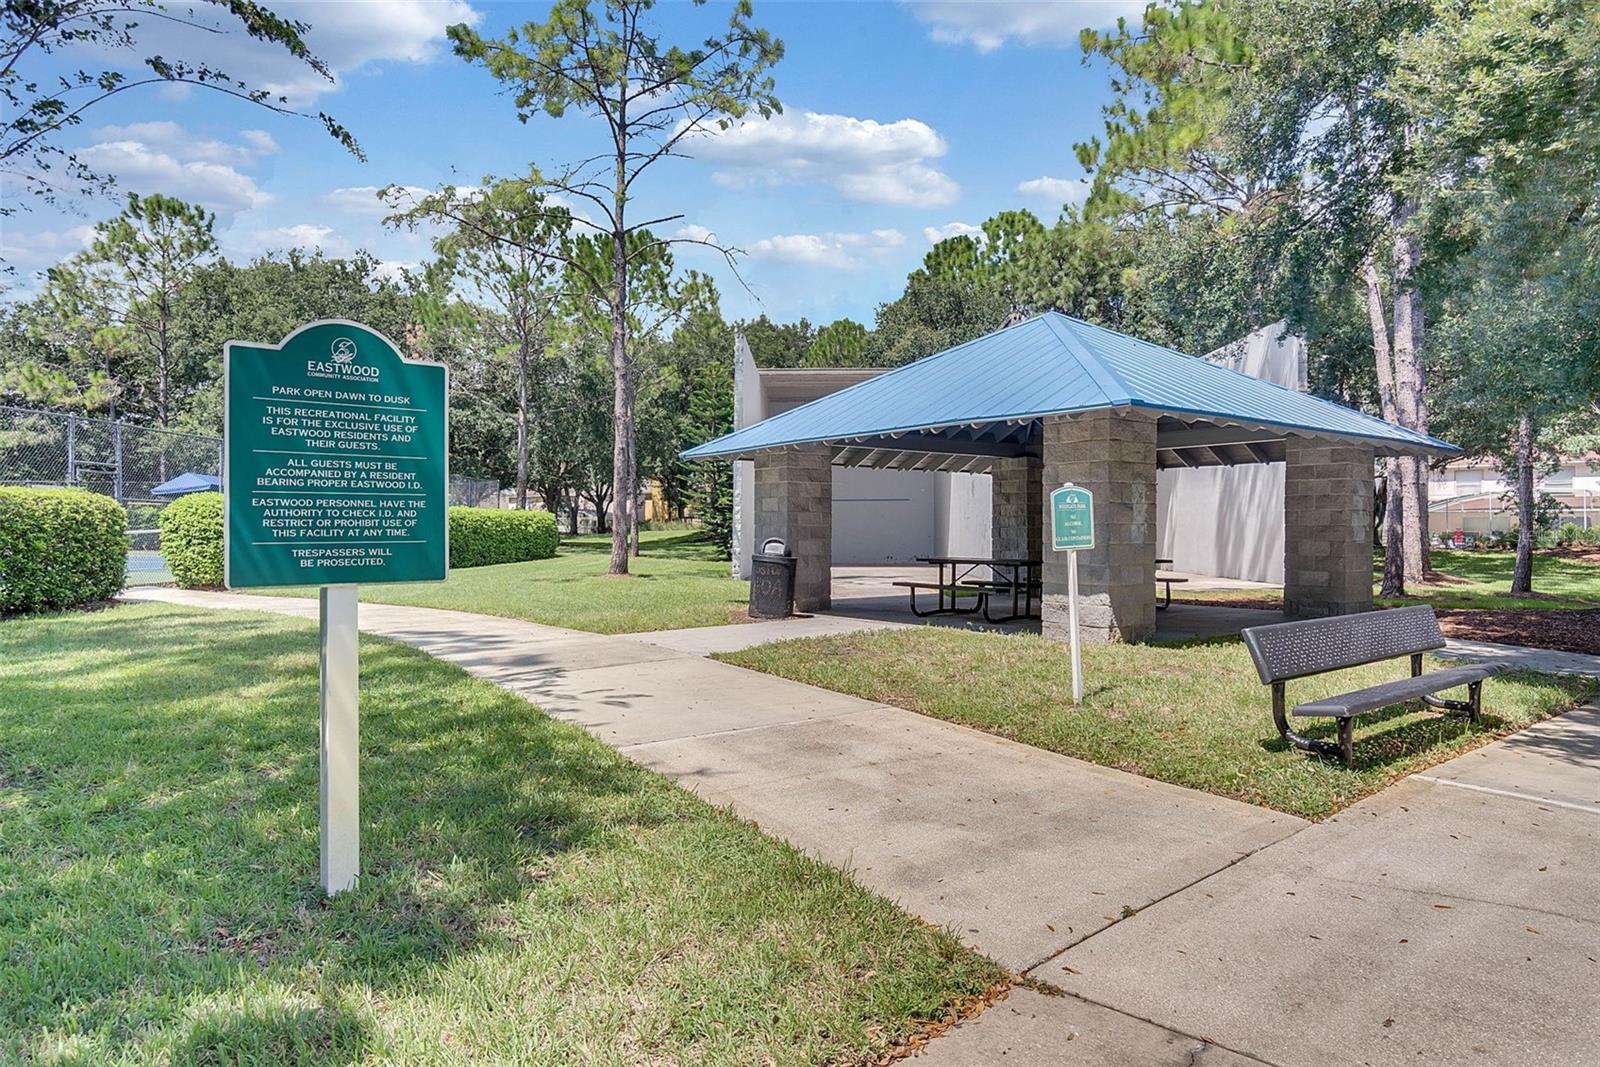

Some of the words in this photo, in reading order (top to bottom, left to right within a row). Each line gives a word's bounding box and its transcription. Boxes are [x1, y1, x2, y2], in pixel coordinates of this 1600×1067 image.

[307, 360, 379, 377] EASTWOOD
[272, 386, 300, 396] PARK
[304, 389, 332, 398] OPEN
[335, 392, 366, 401] DAWN
[369, 394, 381, 402] TO
[384, 396, 410, 404] DUSK
[266, 406, 291, 416] THIS
[294, 408, 371, 421] RECREATIONAL
[374, 414, 416, 423] FACILITY
[263, 416, 273, 424] IS
[277, 417, 298, 426] FOR
[301, 419, 321, 427] THE
[325, 420, 380, 431] EXCLUSIVE
[384, 424, 402, 432] USE
[405, 425, 418, 433] OF
[271, 427, 331, 438] EASTWOOD
[334, 432, 388, 441] RESIDENTS
[391, 434, 411, 442] AND
[305, 438, 336, 448] THEIR
[338, 441, 381, 450] GUESTS.
[287, 458, 308, 467] ALL
[311, 460, 351, 468] GUESTS
[385, 462, 397, 470] BE
[265, 468, 341, 478] ACCOMPANIED
[370, 472, 416, 480] RESIDENT
[257, 478, 304, 487] BEARING
[307, 479, 348, 488] PROPER
[351, 480, 405, 489] EASTWOOD
[252, 498, 313, 507] EASTWOOD
[316, 499, 376, 507] PERSONNEL
[379, 500, 405, 508] HAVE
[263, 509, 323, 517] AUTHORITY
[262, 519, 313, 527] RESTRICT
[316, 519, 331, 527] OR
[334, 519, 380, 527] PROHIBIT
[272, 529, 296, 537] THIS
[300, 529, 344, 537] FACILITY
[292, 549, 365, 557] TRESPASSERS
[368, 548, 392, 556] WILL
[300, 559, 314, 567] BE
[317, 558, 385, 566] PROSECUTED.
